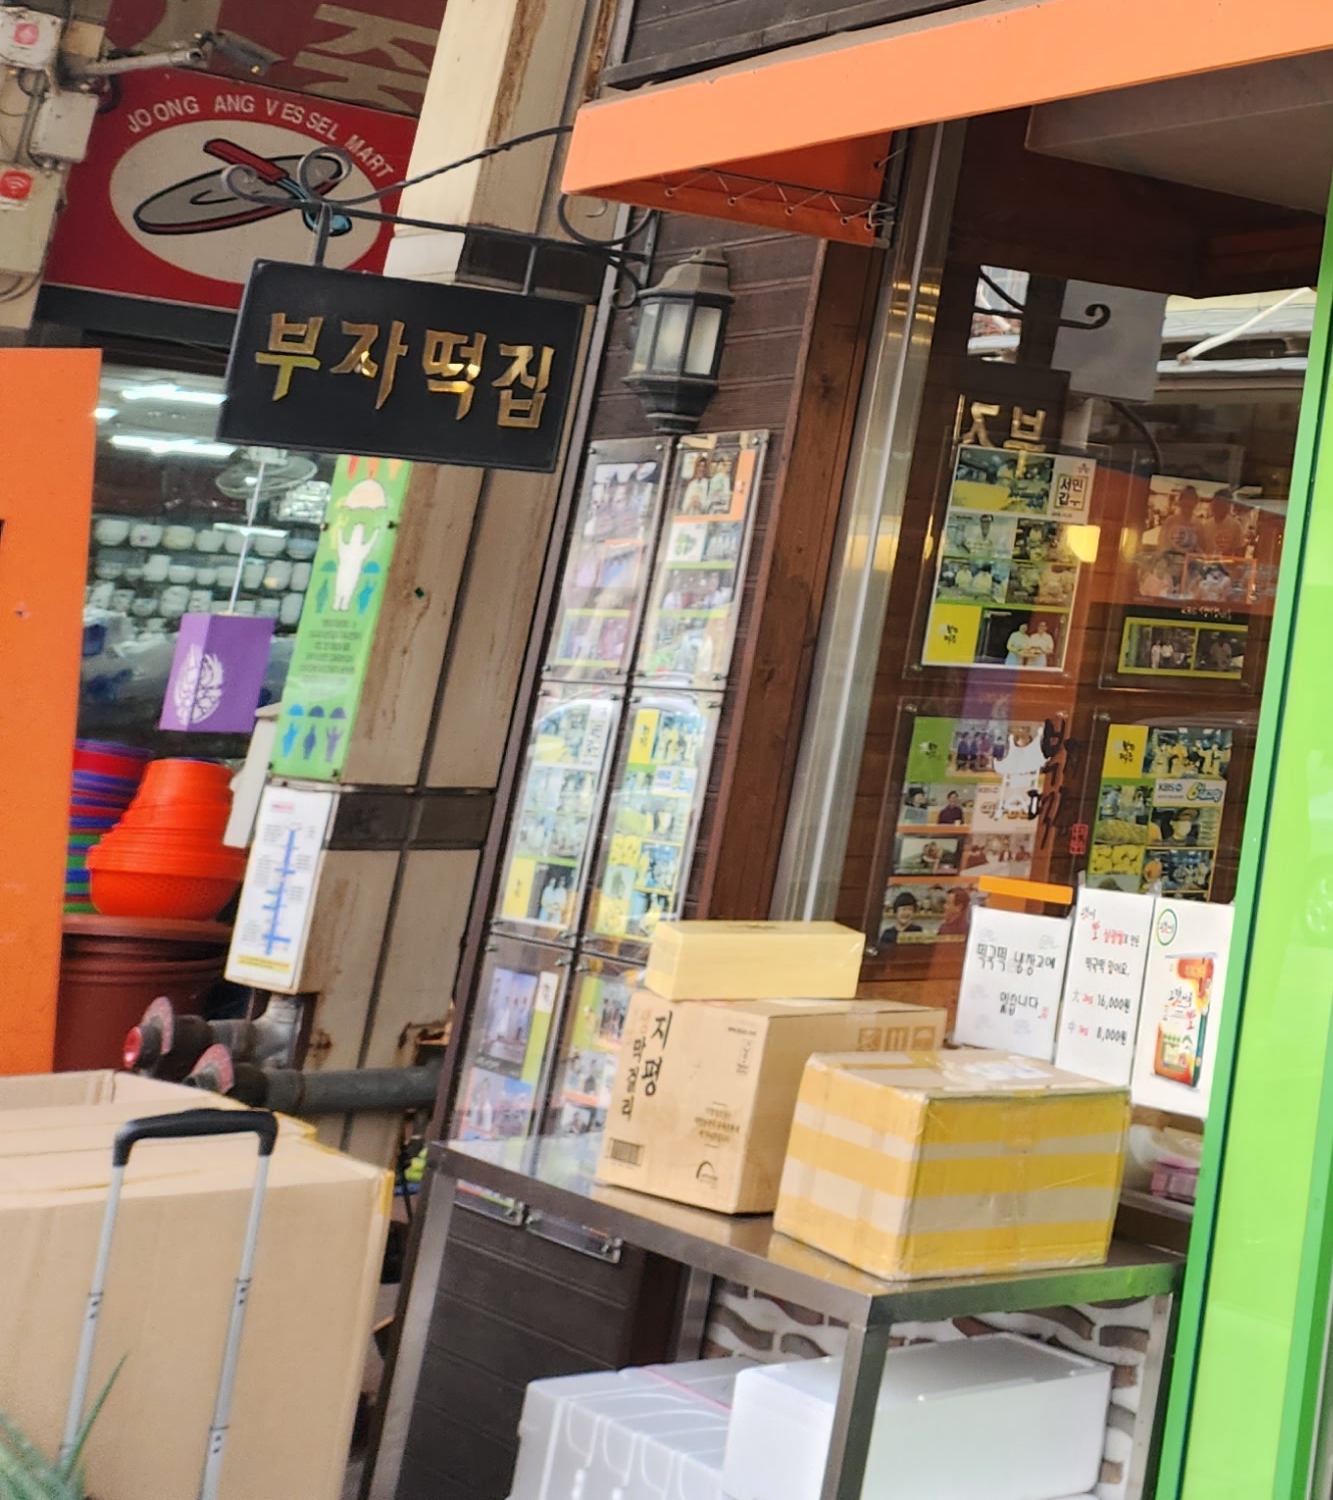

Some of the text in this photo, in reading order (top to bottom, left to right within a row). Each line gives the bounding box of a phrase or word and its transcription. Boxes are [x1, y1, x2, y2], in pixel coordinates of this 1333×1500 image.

[126, 94, 395, 179] JOONG ANG VESSEL MART
[254, 312, 554, 430] 부자떡집
